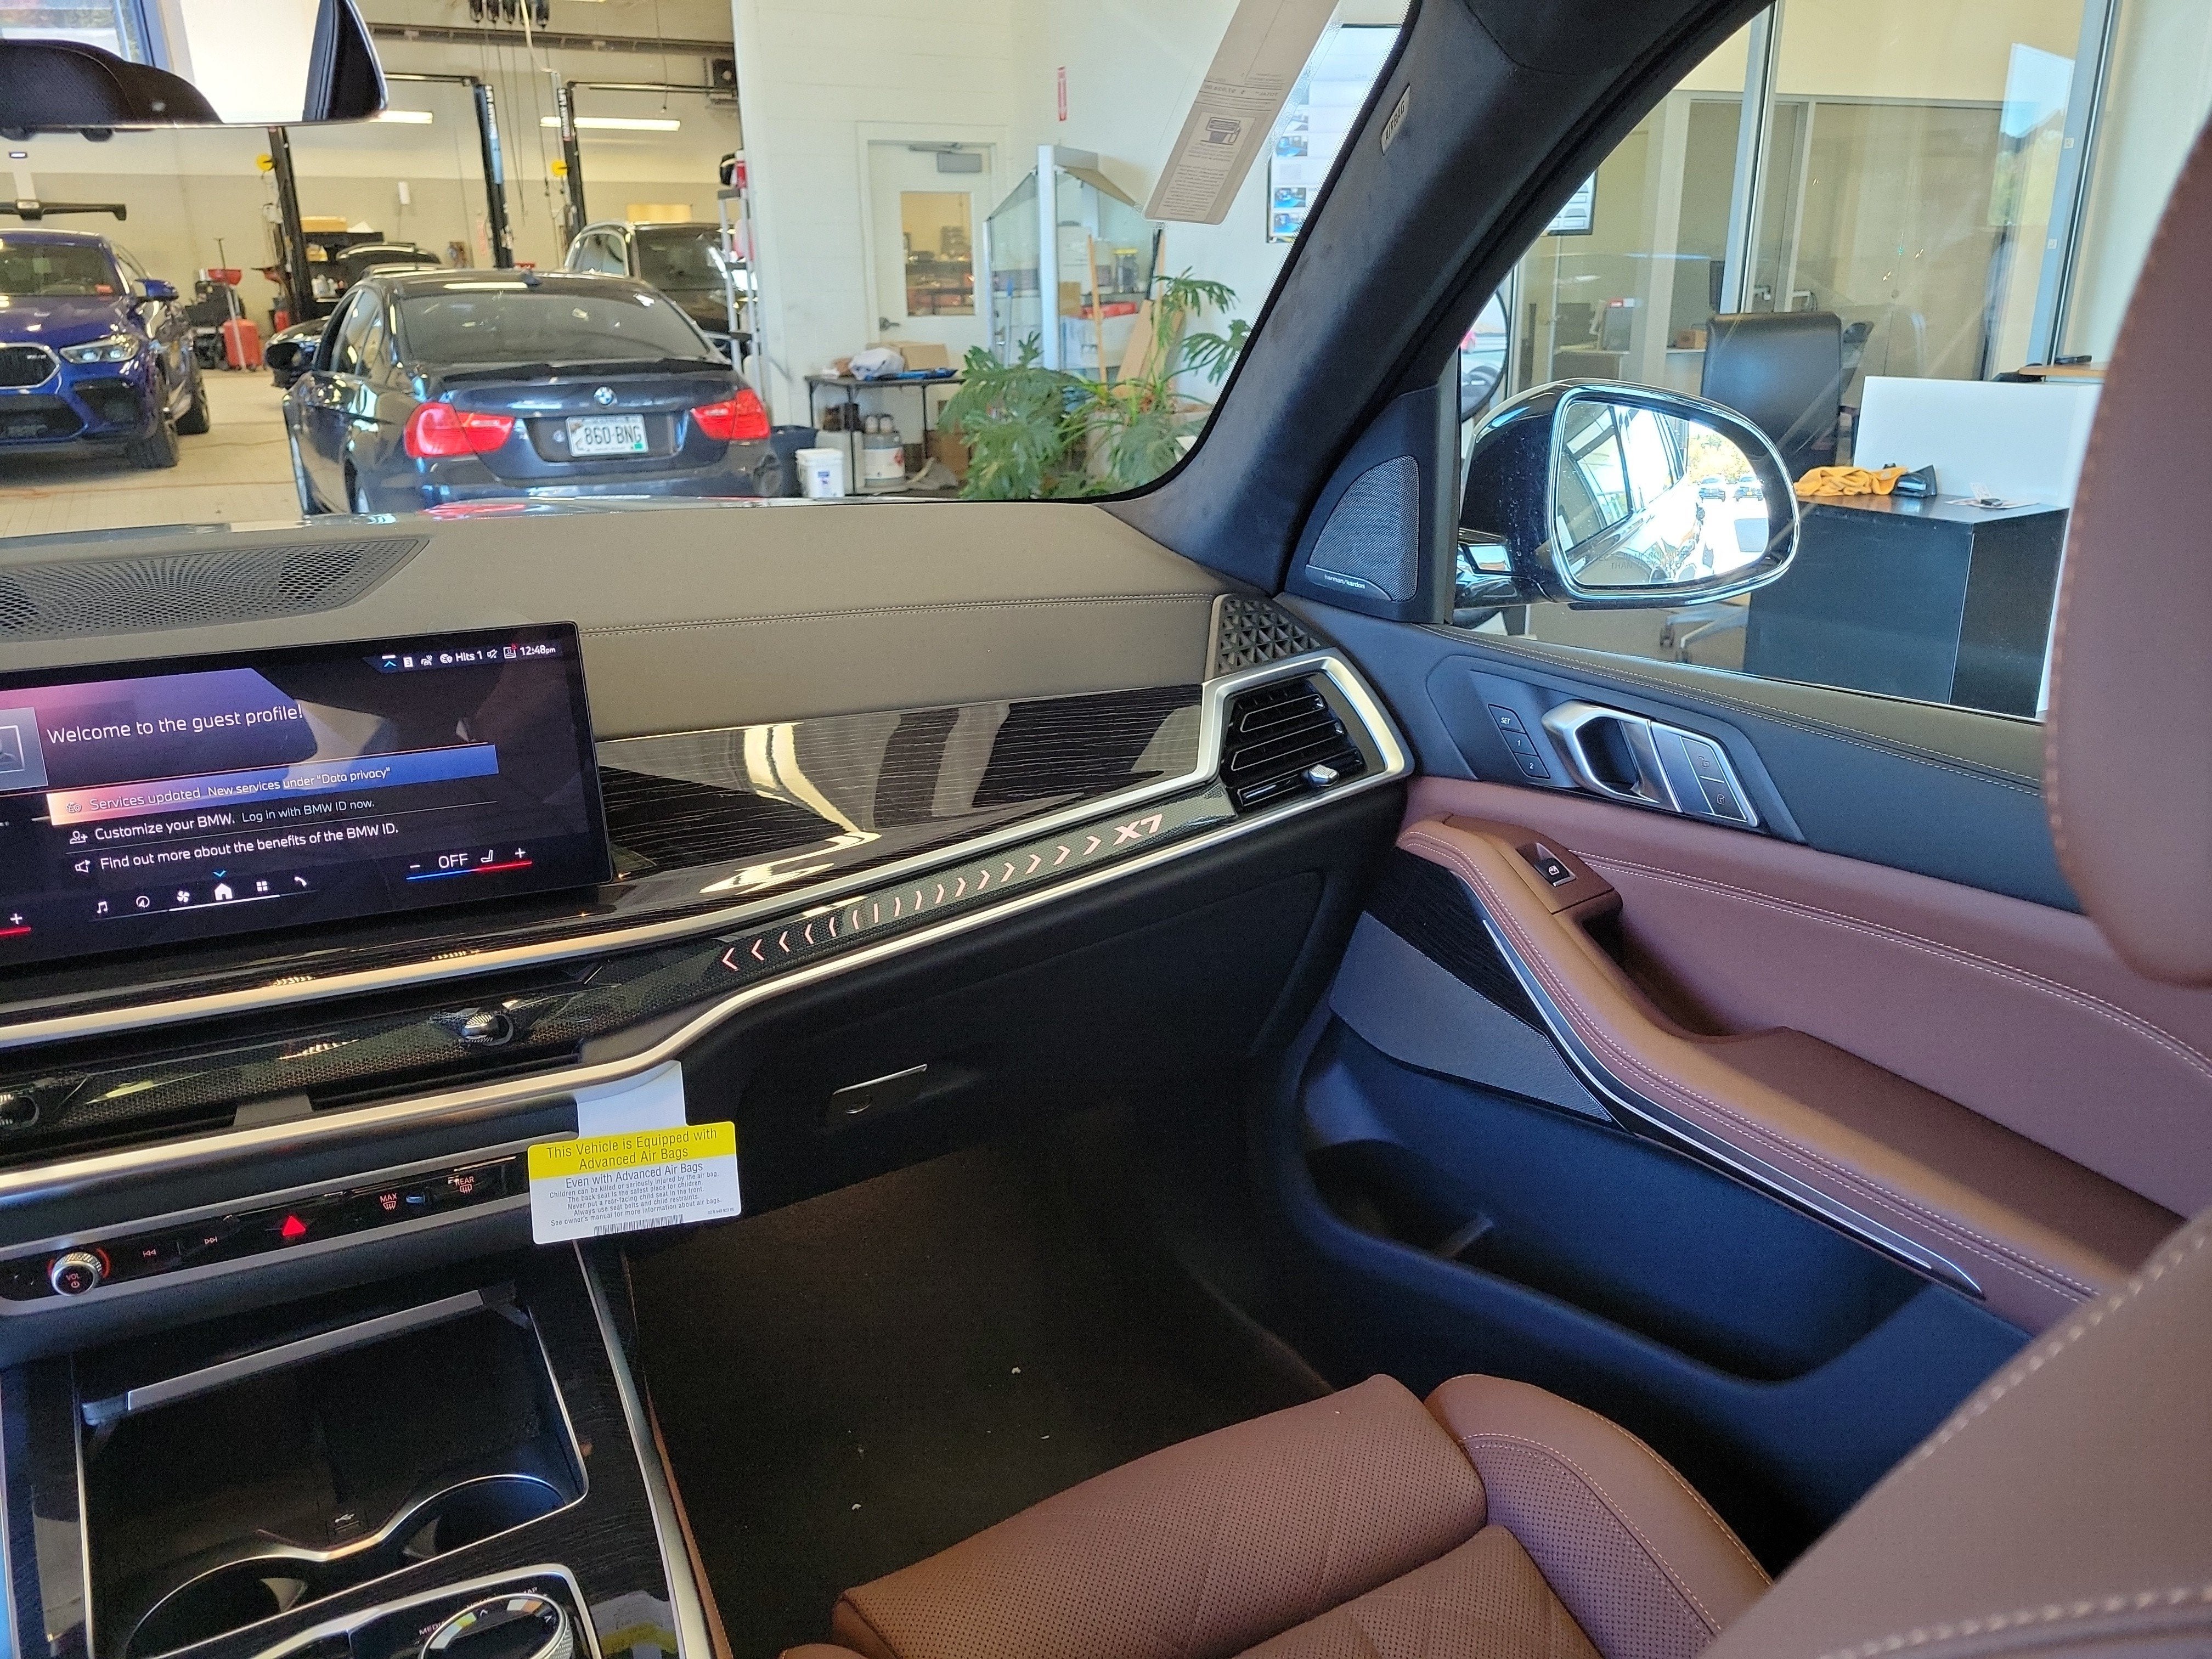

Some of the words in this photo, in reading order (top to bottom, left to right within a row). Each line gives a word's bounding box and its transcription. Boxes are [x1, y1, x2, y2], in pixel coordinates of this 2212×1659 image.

[1385, 100, 1404, 144] AIRBAG
[455, 652, 475, 662] Hits
[47, 724, 131, 745] Welcome
[136, 719, 153, 736] to
[159, 716, 187, 733] the
[192, 710, 241, 733] guest
[245, 704, 304, 731] profile!
[1529, 761, 1533, 770] 2
[89, 794, 145, 811] Services
[148, 787, 201, 805] updated
[207, 786, 233, 797] New
[235, 779, 281, 794] services
[283, 776, 314, 789] under
[316, 771, 348, 785] "Data
[349, 766, 391, 783] privacy"
[95, 821, 162, 841] Customize
[166, 818, 195, 836] your
[197, 812, 235, 828] BMW.
[241, 810, 263, 823] Log
[266, 809, 276, 820] in
[277, 805, 302, 819] with
[303, 802, 334, 816] BMW
[335, 800, 347, 812] ID
[349, 798, 375, 810] now.
[1113, 814, 1162, 846] X7
[100, 854, 129, 870] Find
[133, 853, 154, 867] out
[157, 849, 190, 864] more
[193, 842, 232, 859] about
[233, 839, 255, 854] the
[256, 833, 307, 851] benefits
[308, 831, 321, 844] of
[324, 827, 344, 842] the
[346, 823, 379, 839] BMW
[382, 822, 399, 835] ID.
[438, 853, 469, 869] OFF
[546, 1146, 572, 1159] This
[575, 1141, 618, 1156] Vehicle
[623, 1138, 632, 1150] is
[636, 1130, 689, 1150] Equipped
[693, 1128, 717, 1141] with
[579, 1155, 636, 1171] Advanced
[640, 1149, 657, 1162] Air
[661, 1146, 689, 1161] Bags
[566, 1177, 589, 1188] Even
[592, 1173, 612, 1185] with
[616, 1166, 661, 1182] Advanced
[664, 1164, 678, 1176] Air
[680, 1163, 703, 1174] Bags
[380, 1192, 397, 1203] MAX
[550, 1190, 575, 1199] Children
[600, 1184, 616, 1192] killed
[626, 1179, 653, 1188] seriously
[655, 1176, 675, 1186] injured
[581, 1193, 595, 1201] back
[630, 1186, 648, 1195] safest
[650, 1184, 665, 1193] place
[678, 1180, 703, 1188] children.
[574, 1207, 595, 1217] Always
[670, 1194, 700, 1203] restraints.
[605, 1195, 637, 1205] rear-facing
[564, 1215, 588, 1224] owner's
[590, 1211, 612, 1221] manual
[642, 1203, 676, 1214] information
[65, 1273, 81, 1281] VOL
